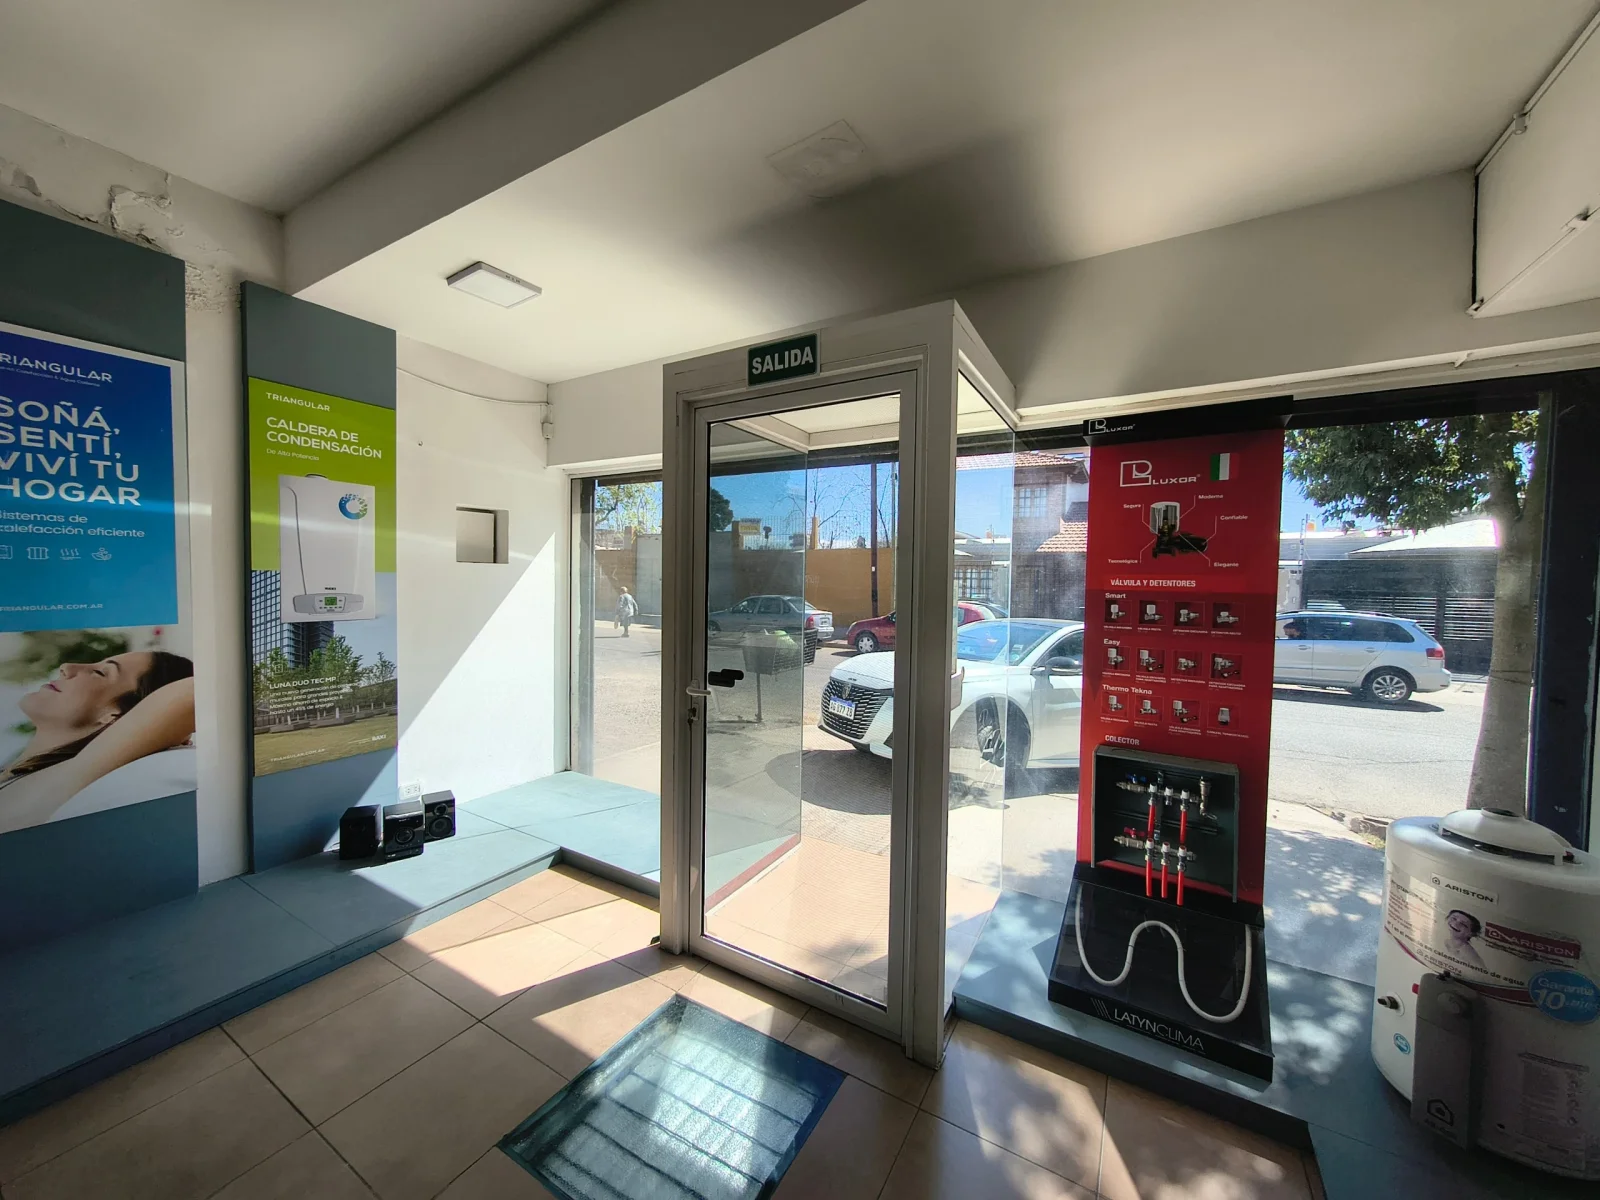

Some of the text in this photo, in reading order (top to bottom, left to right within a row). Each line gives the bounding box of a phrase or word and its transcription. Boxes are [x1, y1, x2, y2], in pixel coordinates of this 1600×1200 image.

[0, 352, 112, 383] RIANGULAR
[752, 346, 814, 375] SALIDA
[266, 392, 330, 412] TRIANGULAR
[0, 395, 120, 435] SOÑÁ,
[266, 417, 359, 443] CALDERA DE
[1106, 425, 1133, 433] LUXOR
[0, 422, 121, 459] SENTÍ,
[266, 431, 382, 459] CONDENSACIÓN
[0, 451, 139, 482] VIVÍ TU
[292, 452, 320, 461] Potencia
[1152, 476, 1197, 486] LUXOR
[0, 477, 141, 506] HOGAR
[69, 512, 88, 524] de
[87, 526, 145, 538] eficiente
[1110, 577, 1141, 587] VÁLVULA
[1150, 579, 1196, 587] DETENTORES
[1104, 638, 1121, 646] Easy
[269, 681, 291, 690] LUNA
[292, 679, 310, 687] DUO
[311, 677, 325, 685] TEC
[1102, 684, 1153, 695] Thermo Tekna
[1105, 735, 1140, 746] COLECTOR
[1445, 883, 1494, 903] ARISTON
[1509, 937, 1574, 956] ARISTON
[1433, 949, 1489, 975] calentamiento
[1490, 971, 1501, 979] de
[1502, 976, 1525, 986] agua
[1534, 988, 1566, 1010] 10
[1114, 1008, 1205, 1050] LATYNCLIMA
